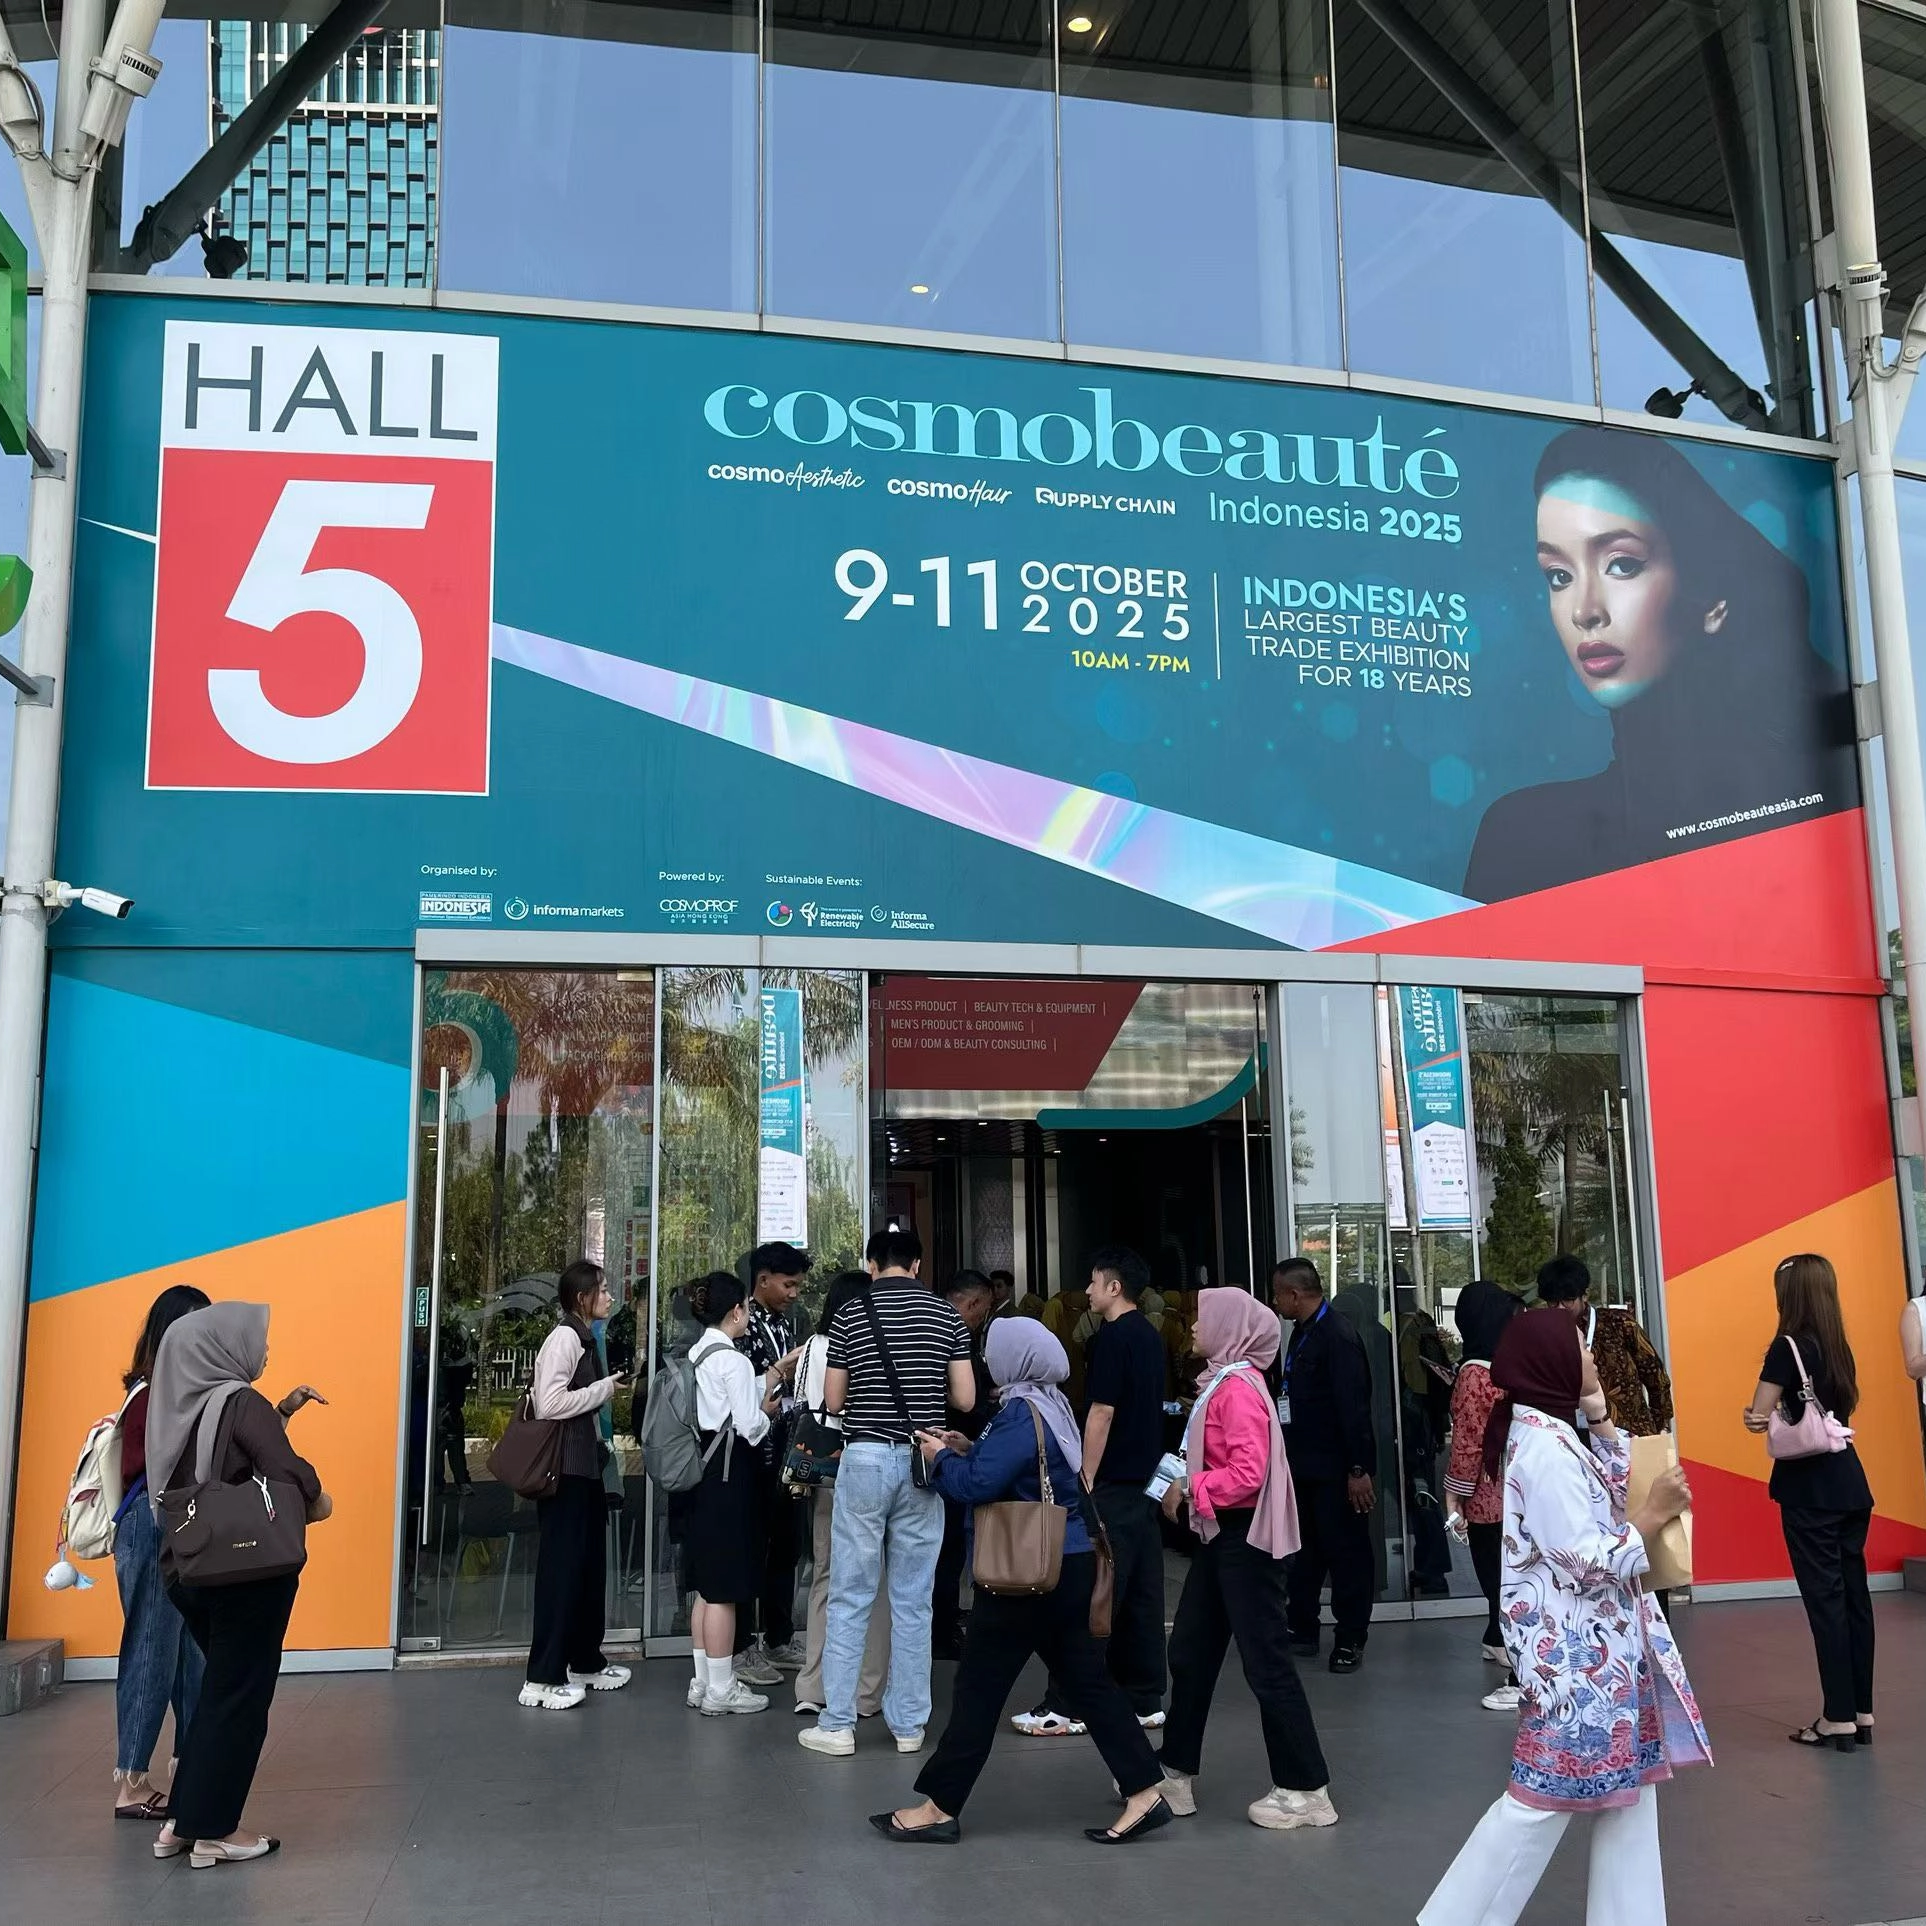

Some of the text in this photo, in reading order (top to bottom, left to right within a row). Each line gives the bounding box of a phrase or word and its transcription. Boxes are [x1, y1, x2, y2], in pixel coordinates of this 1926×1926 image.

[185, 343, 478, 441] HALL
[704, 384, 1460, 499] cosmobeauté
[1115, 496, 1176, 515] CHAIN
[1210, 492, 1463, 543] Indonesia 2025
[1020, 560, 1188, 600] OCTOBER
[834, 549, 998, 630] 9-11
[1243, 576, 1467, 622] INDONESIA'S
[207, 479, 436, 764] 5
[1244, 608, 1469, 646] LARGEST BEAUTY
[1246, 635, 1470, 672] TRADE EXHIBITION
[1071, 650, 1130, 671] 10AM
[1146, 654, 1190, 675] 7PM
[1299, 665, 1472, 697] FOR 18 YEARS
[1665, 792, 1824, 840] www.cosmobeauteasia.com
[421, 865, 497, 878] Organised by:
[659, 871, 725, 883] Powered by:
[765, 873, 863, 887] Sustainable Events:
[421, 901, 491, 915] INDONESIA
[659, 899, 739, 912] COSMOPROF
[820, 912, 864, 920] Renewable
[891, 910, 927, 920] Informa
[820, 920, 860, 929] Electricity
[891, 921, 935, 930] AllSecure
[915, 1000, 957, 1012] PRODUCT
[974, 1002, 1096, 1014] BEAUTY TECH & EQUIPMENT
[891, 1018, 1024, 1032] MEN'S PRODUCT & GROOMING
[892, 1038, 912, 1049] OEM
[920, 1038, 942, 1049] ODM
[944, 1038, 951, 1049] &
[953, 1039, 989, 1049] BEAUTY
[991, 1039, 1047, 1051] CONSULTING
